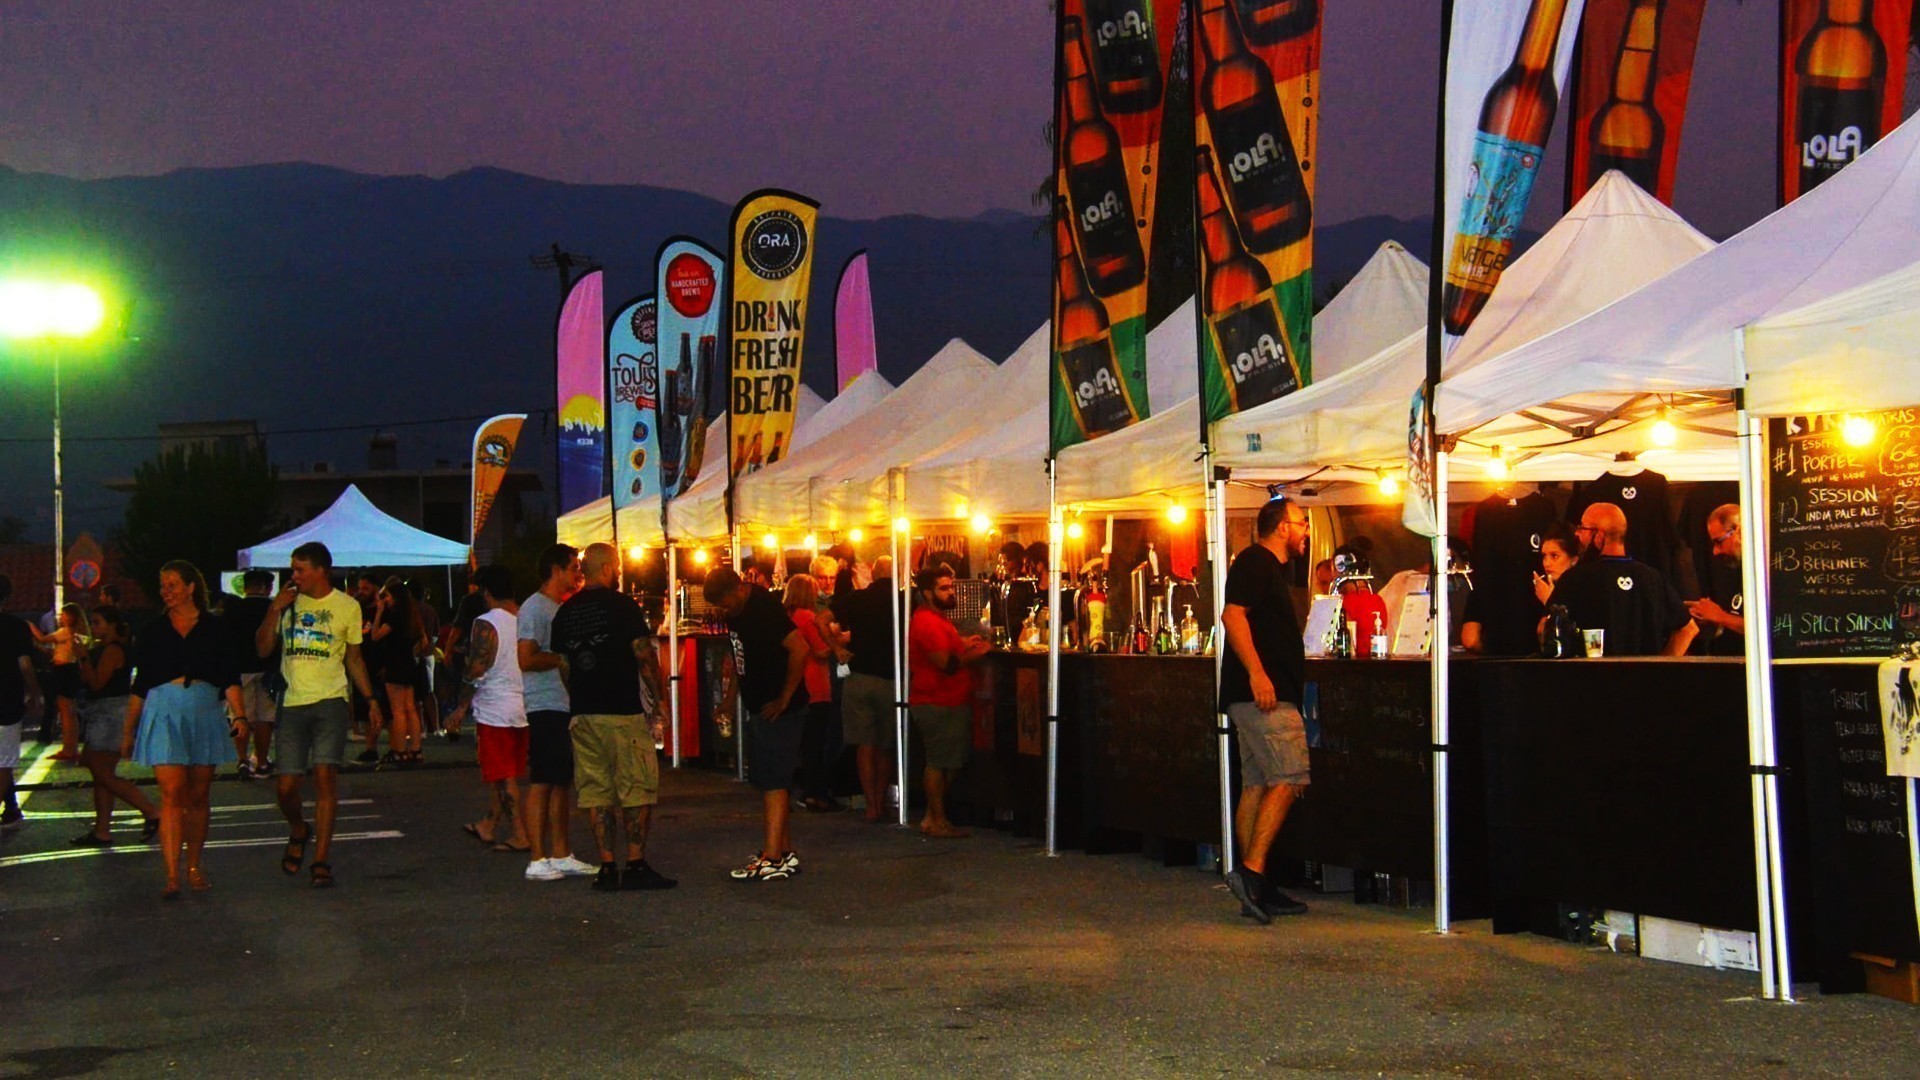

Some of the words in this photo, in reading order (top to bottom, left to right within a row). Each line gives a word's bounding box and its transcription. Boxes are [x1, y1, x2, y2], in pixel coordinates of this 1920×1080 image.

[735, 300, 802, 333] DRINK
[734, 337, 799, 370] FRESH
[1231, 334, 1286, 383] LOLA!
[733, 375, 795, 415] BEER
[1773, 444, 1797, 477] #1
[1802, 454, 1863, 474] PORTER
[1808, 484, 1878, 505] SESSION
[1806, 507, 1832, 523] INDIA
[1835, 507, 1859, 520] PALE
[1860, 505, 1880, 518] ALE
[1771, 548, 1800, 572] #3
[1803, 555, 1870, 572] BERLINER
[1803, 573, 1857, 585] WEISSE
[1772, 612, 1793, 637] #4
[1801, 612, 1842, 634] SPICY
[1845, 612, 1893, 633] SAISON
[1830, 688, 1869, 712] T-SHIRT
